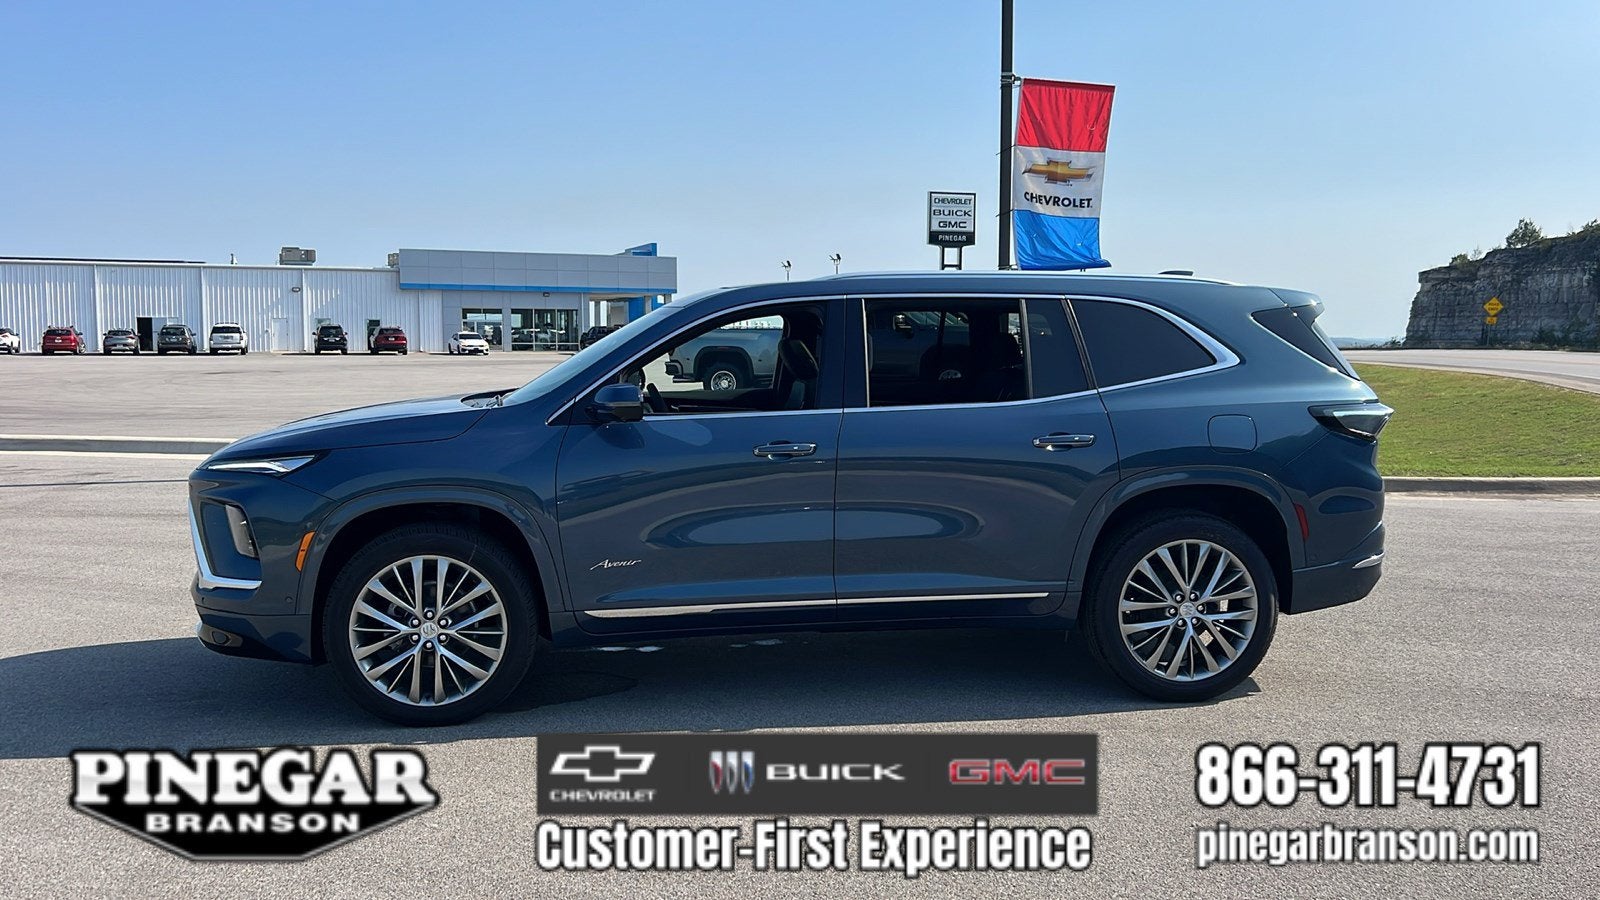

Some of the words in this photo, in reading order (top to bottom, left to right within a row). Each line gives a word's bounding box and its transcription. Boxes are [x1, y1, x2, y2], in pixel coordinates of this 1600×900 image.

[933, 197, 973, 206] CHEVROLET
[1024, 191, 1092, 209] CHEVROLET
[932, 208, 973, 217] BUICK
[938, 220, 968, 229] GMC
[938, 234, 967, 242] PINEGAR
[589, 558, 642, 571] Avenir
